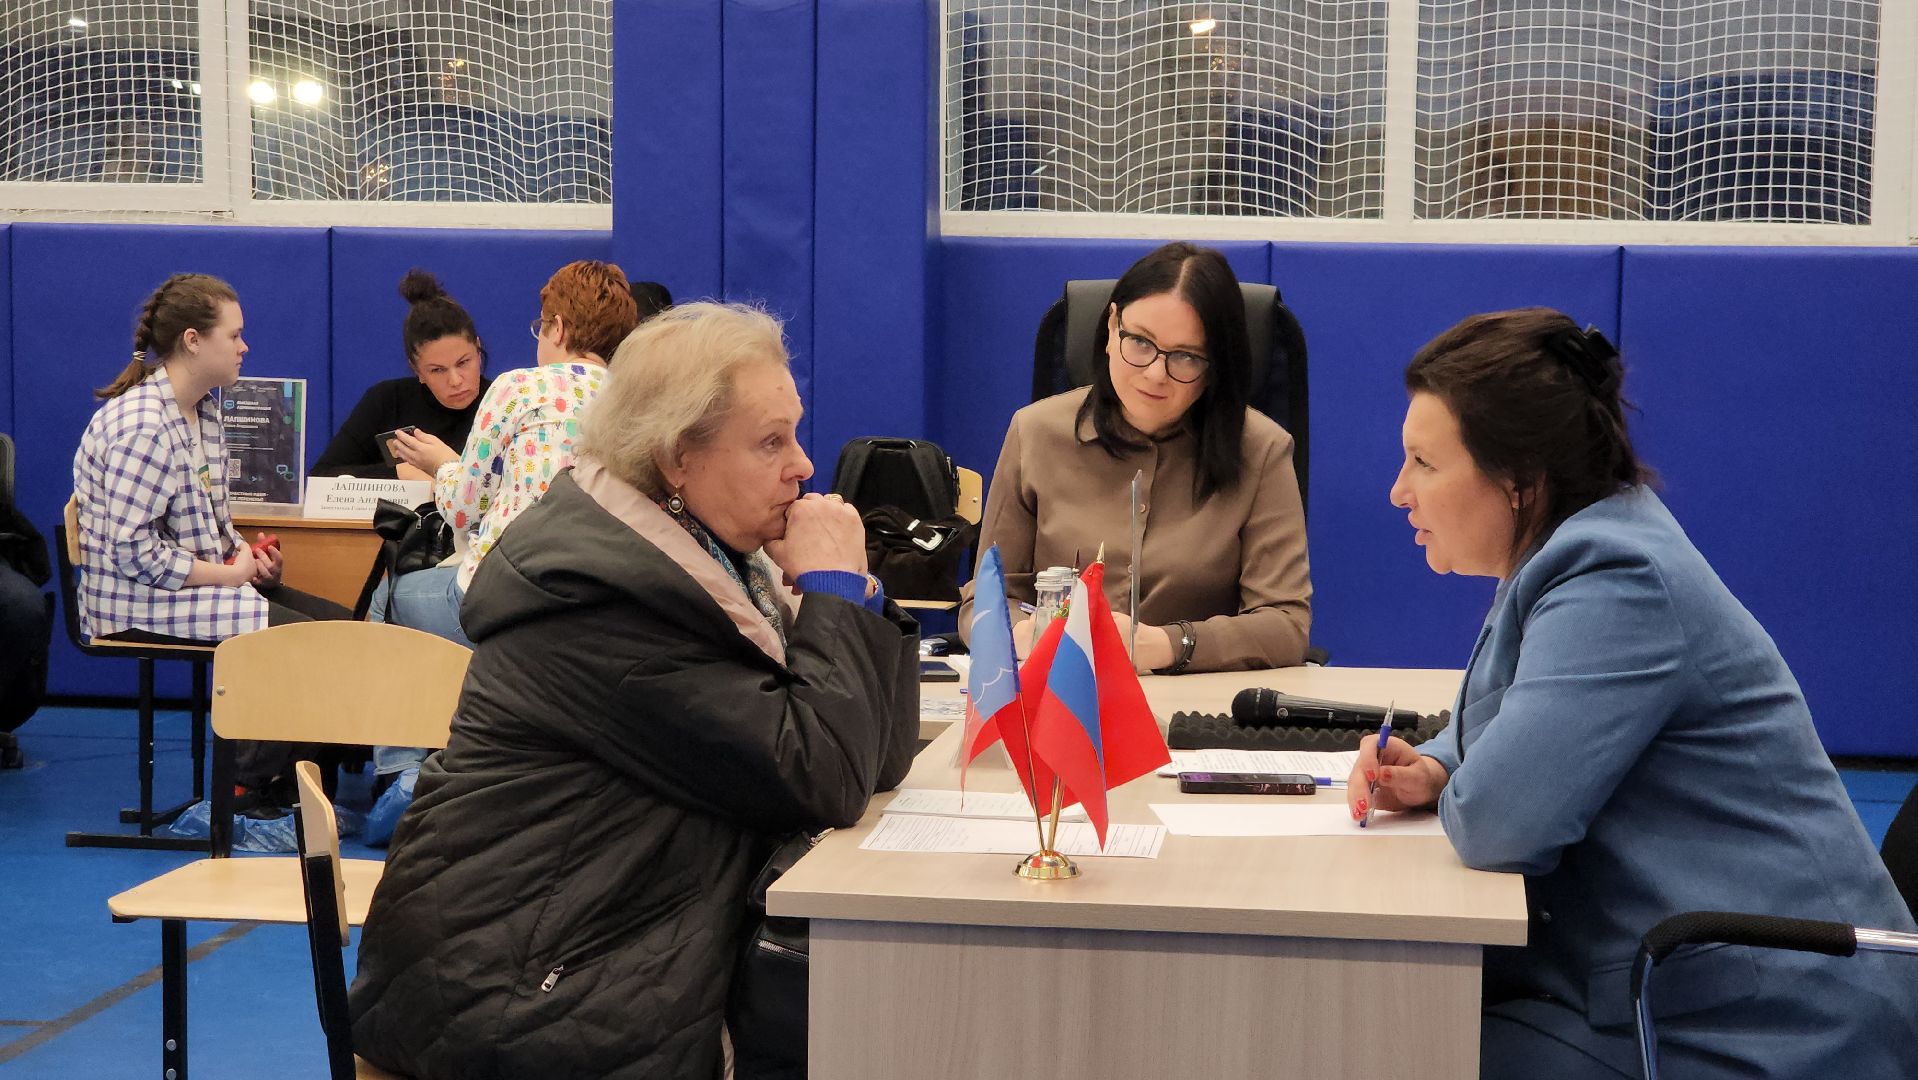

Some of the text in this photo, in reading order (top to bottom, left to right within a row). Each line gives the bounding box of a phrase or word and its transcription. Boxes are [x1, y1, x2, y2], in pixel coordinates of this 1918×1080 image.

[223, 415, 270, 424] ЛАПШИНОВА
[331, 482, 406, 492] ЛАПШИНОВА
[326, 494, 409, 505] Елена Андвна
